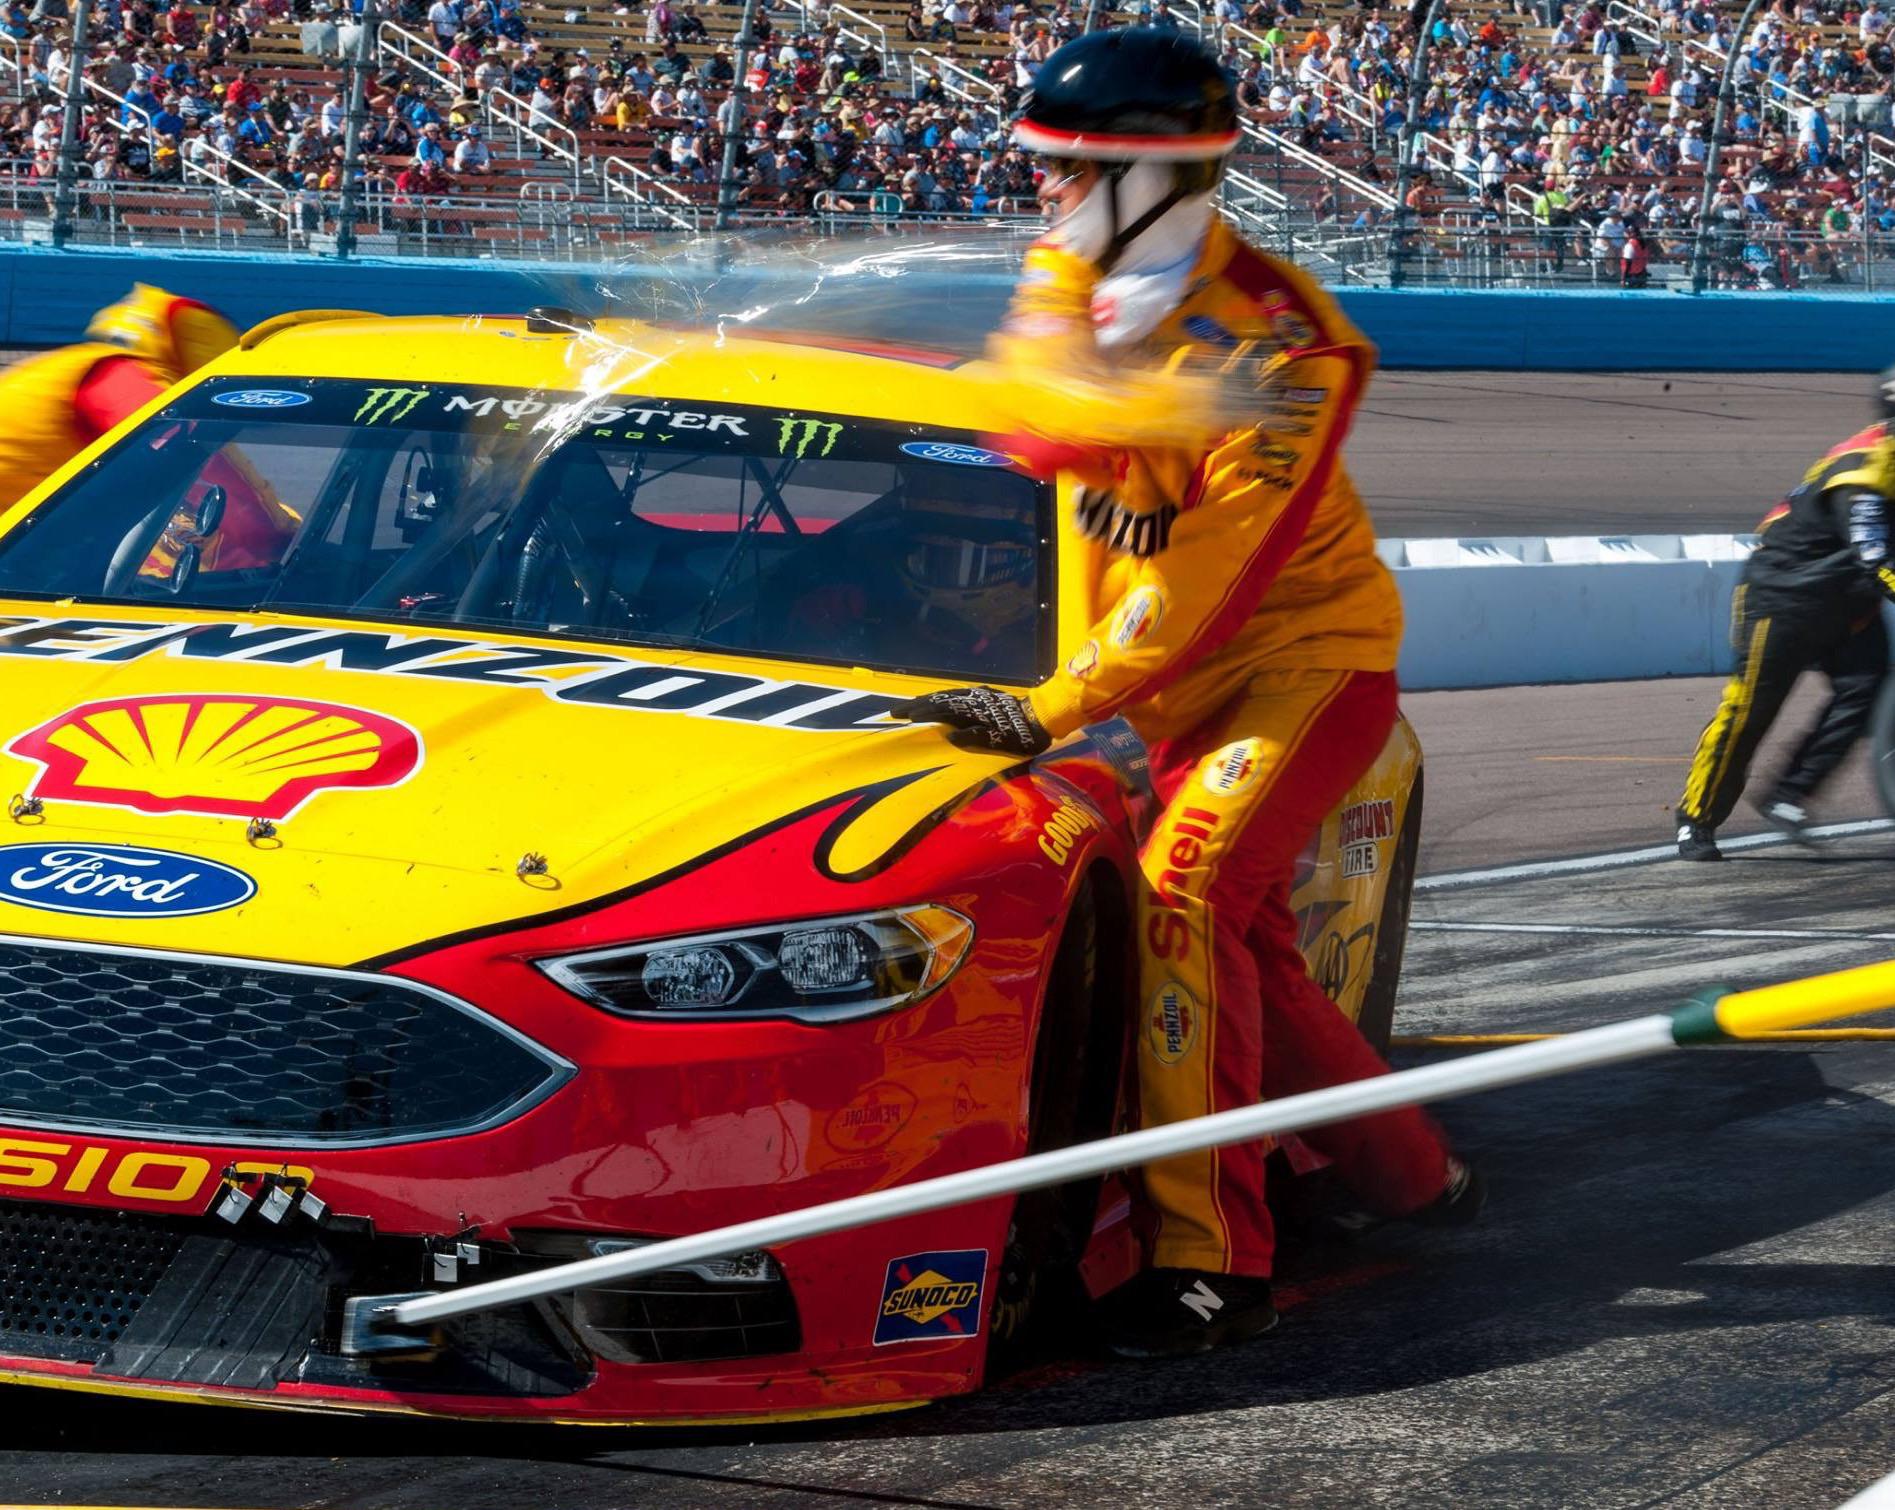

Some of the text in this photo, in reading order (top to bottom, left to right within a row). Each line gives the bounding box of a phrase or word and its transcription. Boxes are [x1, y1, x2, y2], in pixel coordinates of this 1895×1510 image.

[443, 396, 749, 436] MOSTER
[503, 422, 674, 442] ERGY
[929, 444, 993, 464] Ford
[0, 617, 911, 730] ENNZOIL
[9, 849, 200, 904] Ford
[1345, 846, 1374, 874] TIRE
[1147, 806, 1221, 962] Shell
[1162, 992, 1182, 1053] PENNZOIL
[885, 1285, 976, 1313] SUNOCO
